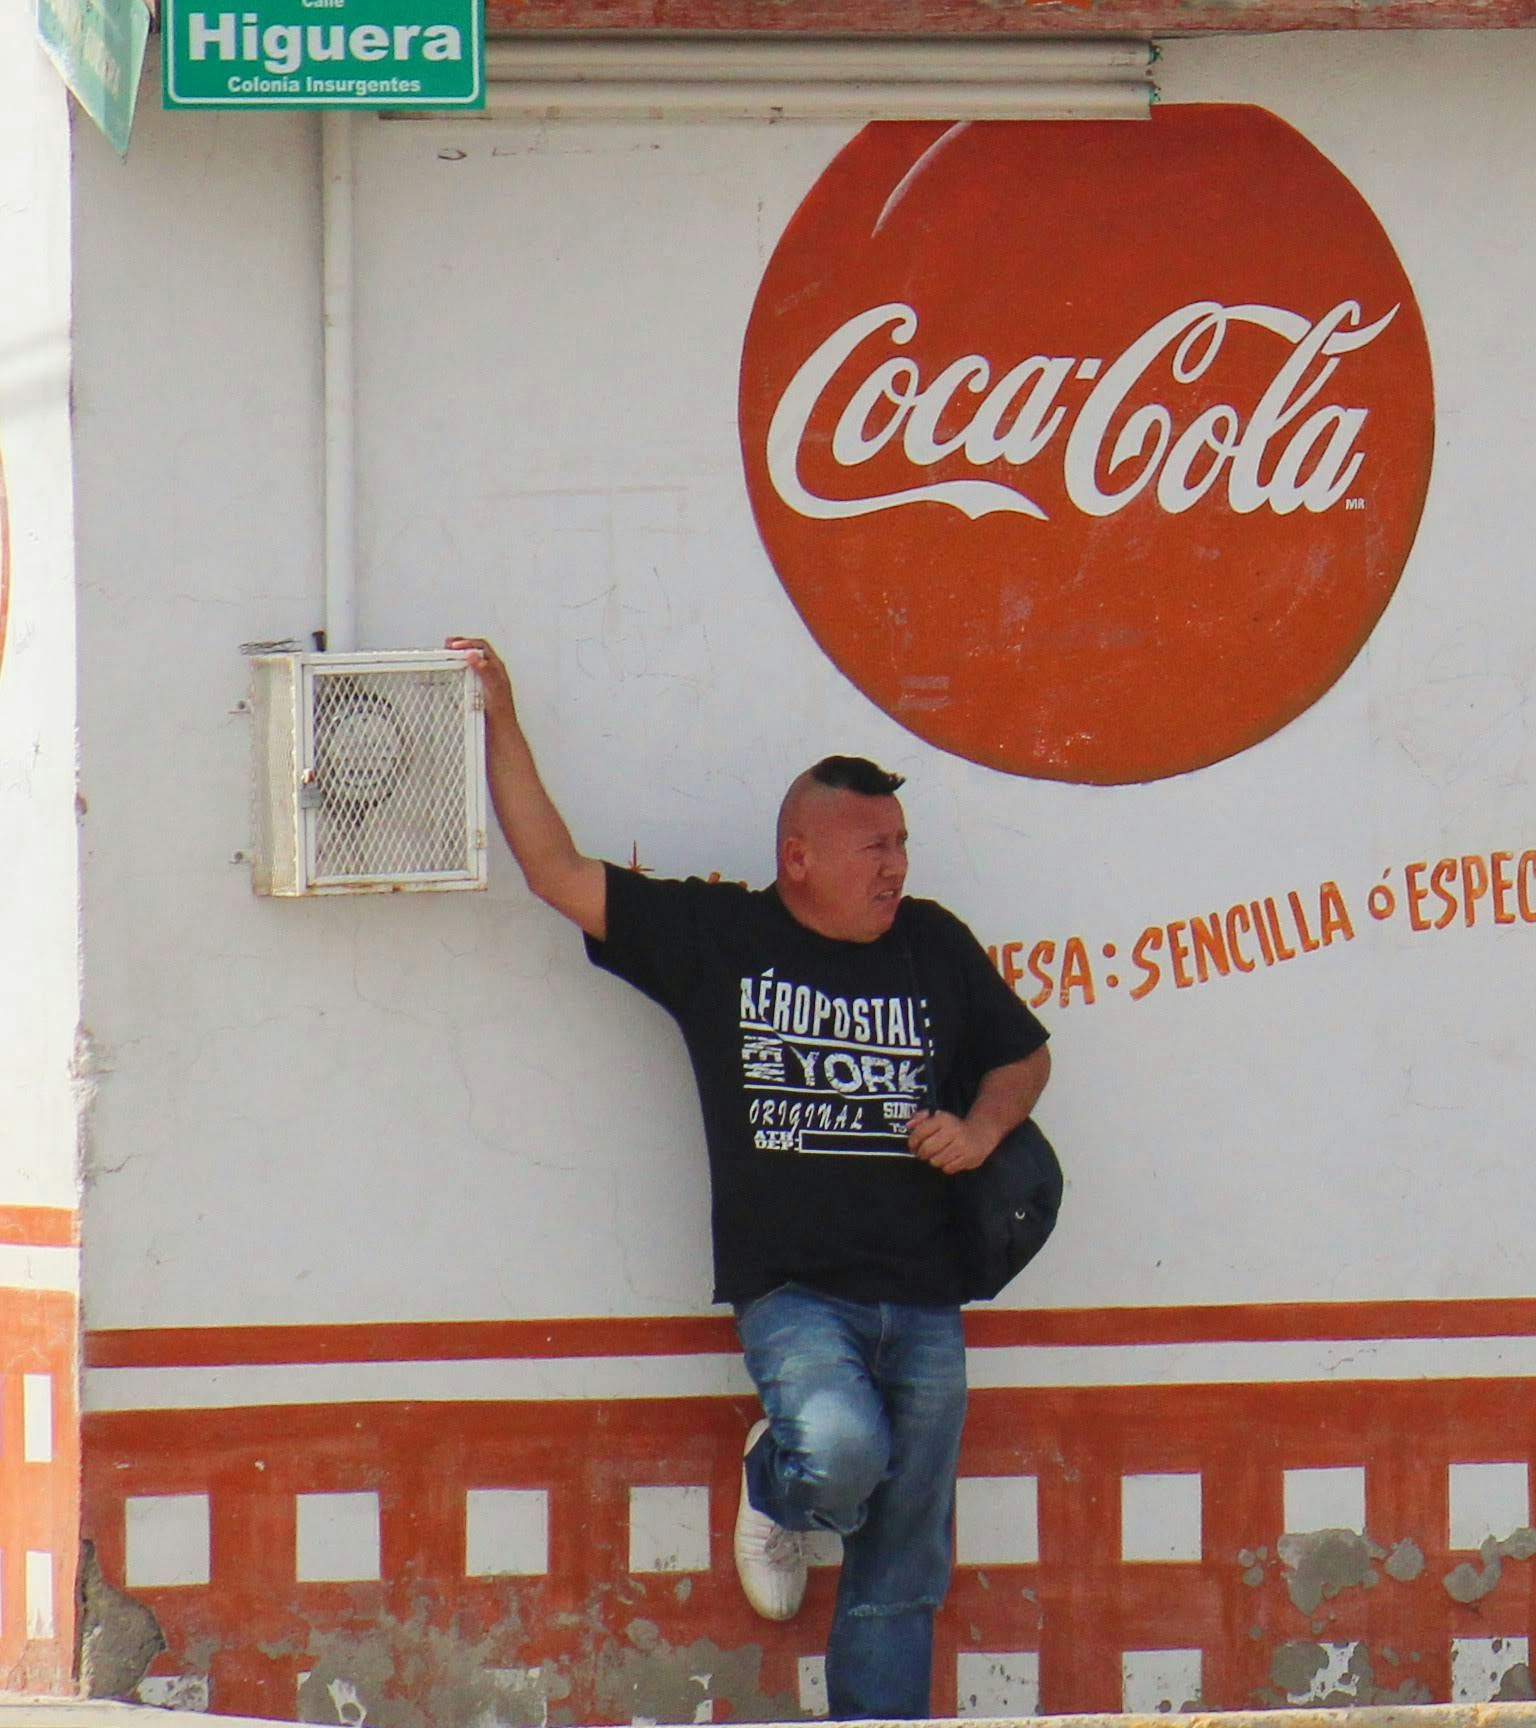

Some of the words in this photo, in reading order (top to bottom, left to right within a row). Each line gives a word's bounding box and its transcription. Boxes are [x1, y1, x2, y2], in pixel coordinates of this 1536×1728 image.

[188, 13, 462, 74] Higuera
[227, 76, 300, 92] Colonia
[306, 76, 421, 96] Insurgentes
[766, 300, 1401, 521] Coca-Cola
[1129, 880, 1356, 1001] SENCILLA
[739, 967, 934, 1057] AÉROPOSTAL
[789, 1046, 928, 1093] YORK
